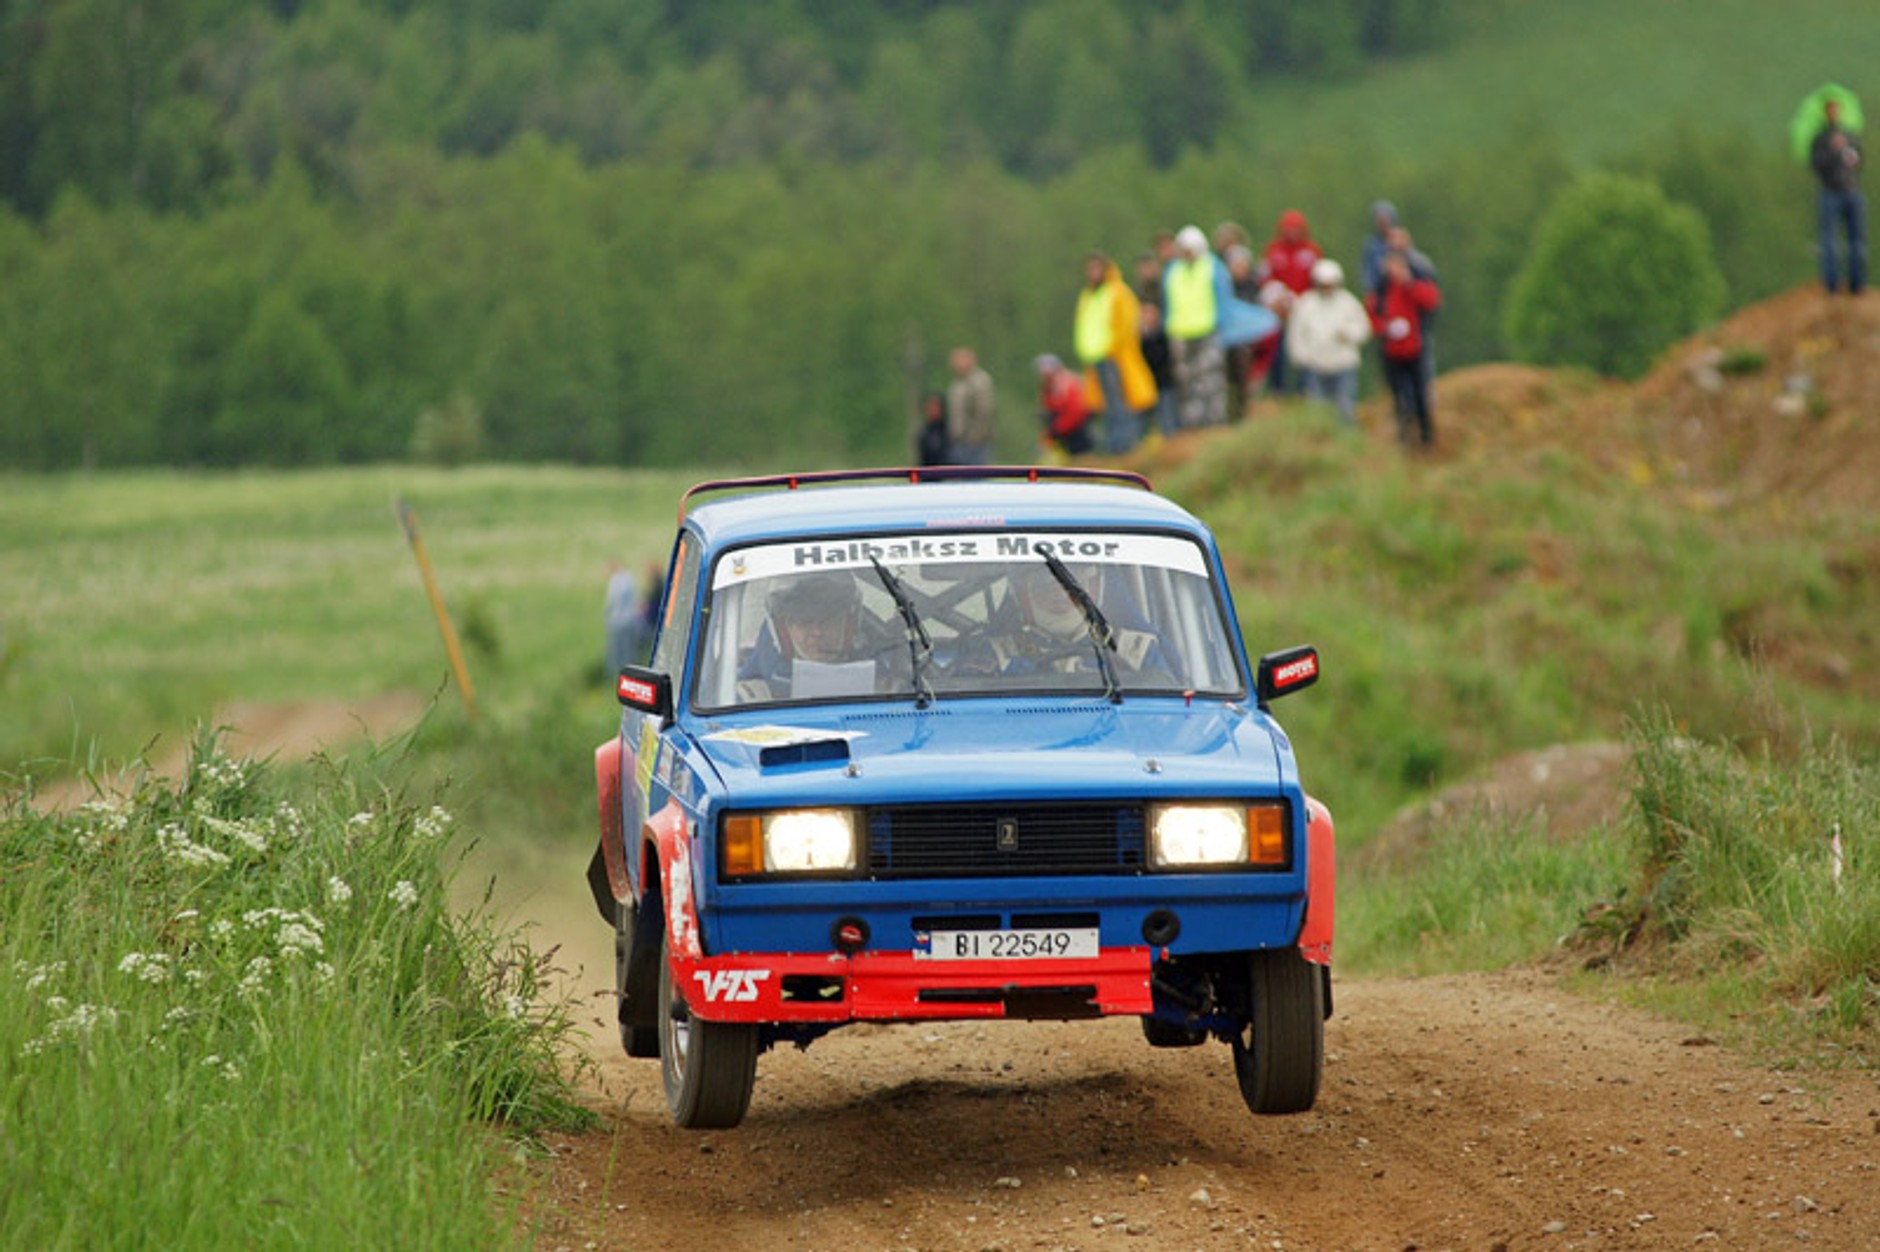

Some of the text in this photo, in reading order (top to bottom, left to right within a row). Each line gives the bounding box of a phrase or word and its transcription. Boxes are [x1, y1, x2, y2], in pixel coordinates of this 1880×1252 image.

[794, 537, 1119, 566] Halbaksz Motor
[989, 932, 1071, 957] 22549
